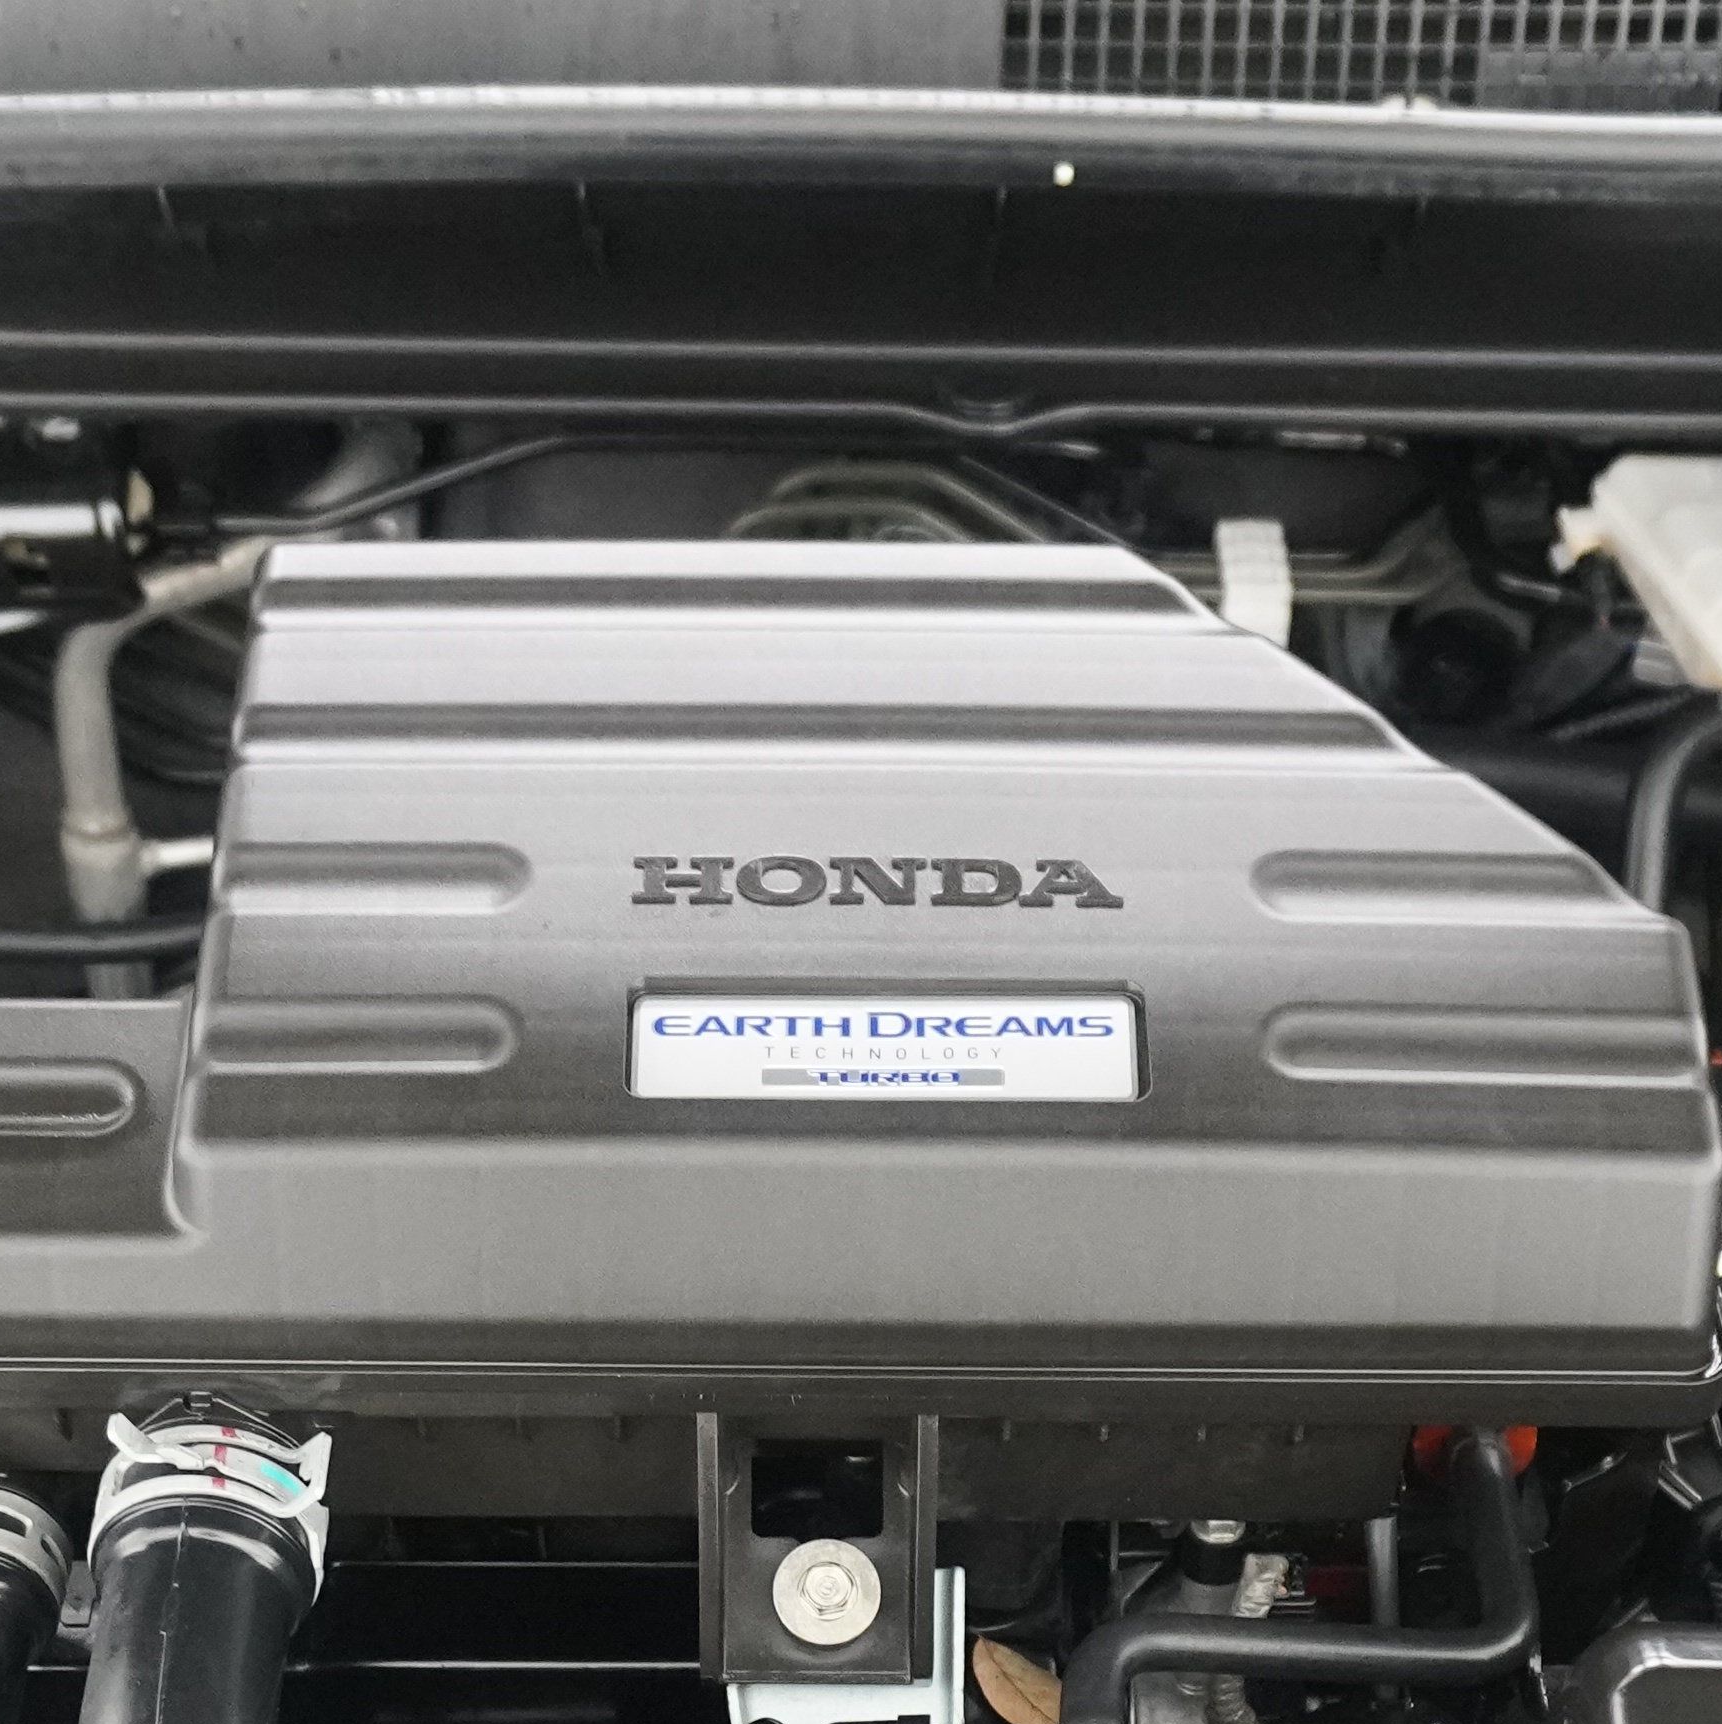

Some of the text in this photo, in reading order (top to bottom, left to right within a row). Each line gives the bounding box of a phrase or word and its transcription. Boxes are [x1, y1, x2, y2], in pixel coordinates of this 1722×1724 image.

[631, 855, 1125, 909] HONDA
[651, 1011, 1115, 1038] EARTH DREAMS
[765, 1045, 1004, 1060] TECHNOLOGY
[807, 1068, 961, 1086] TURBO
